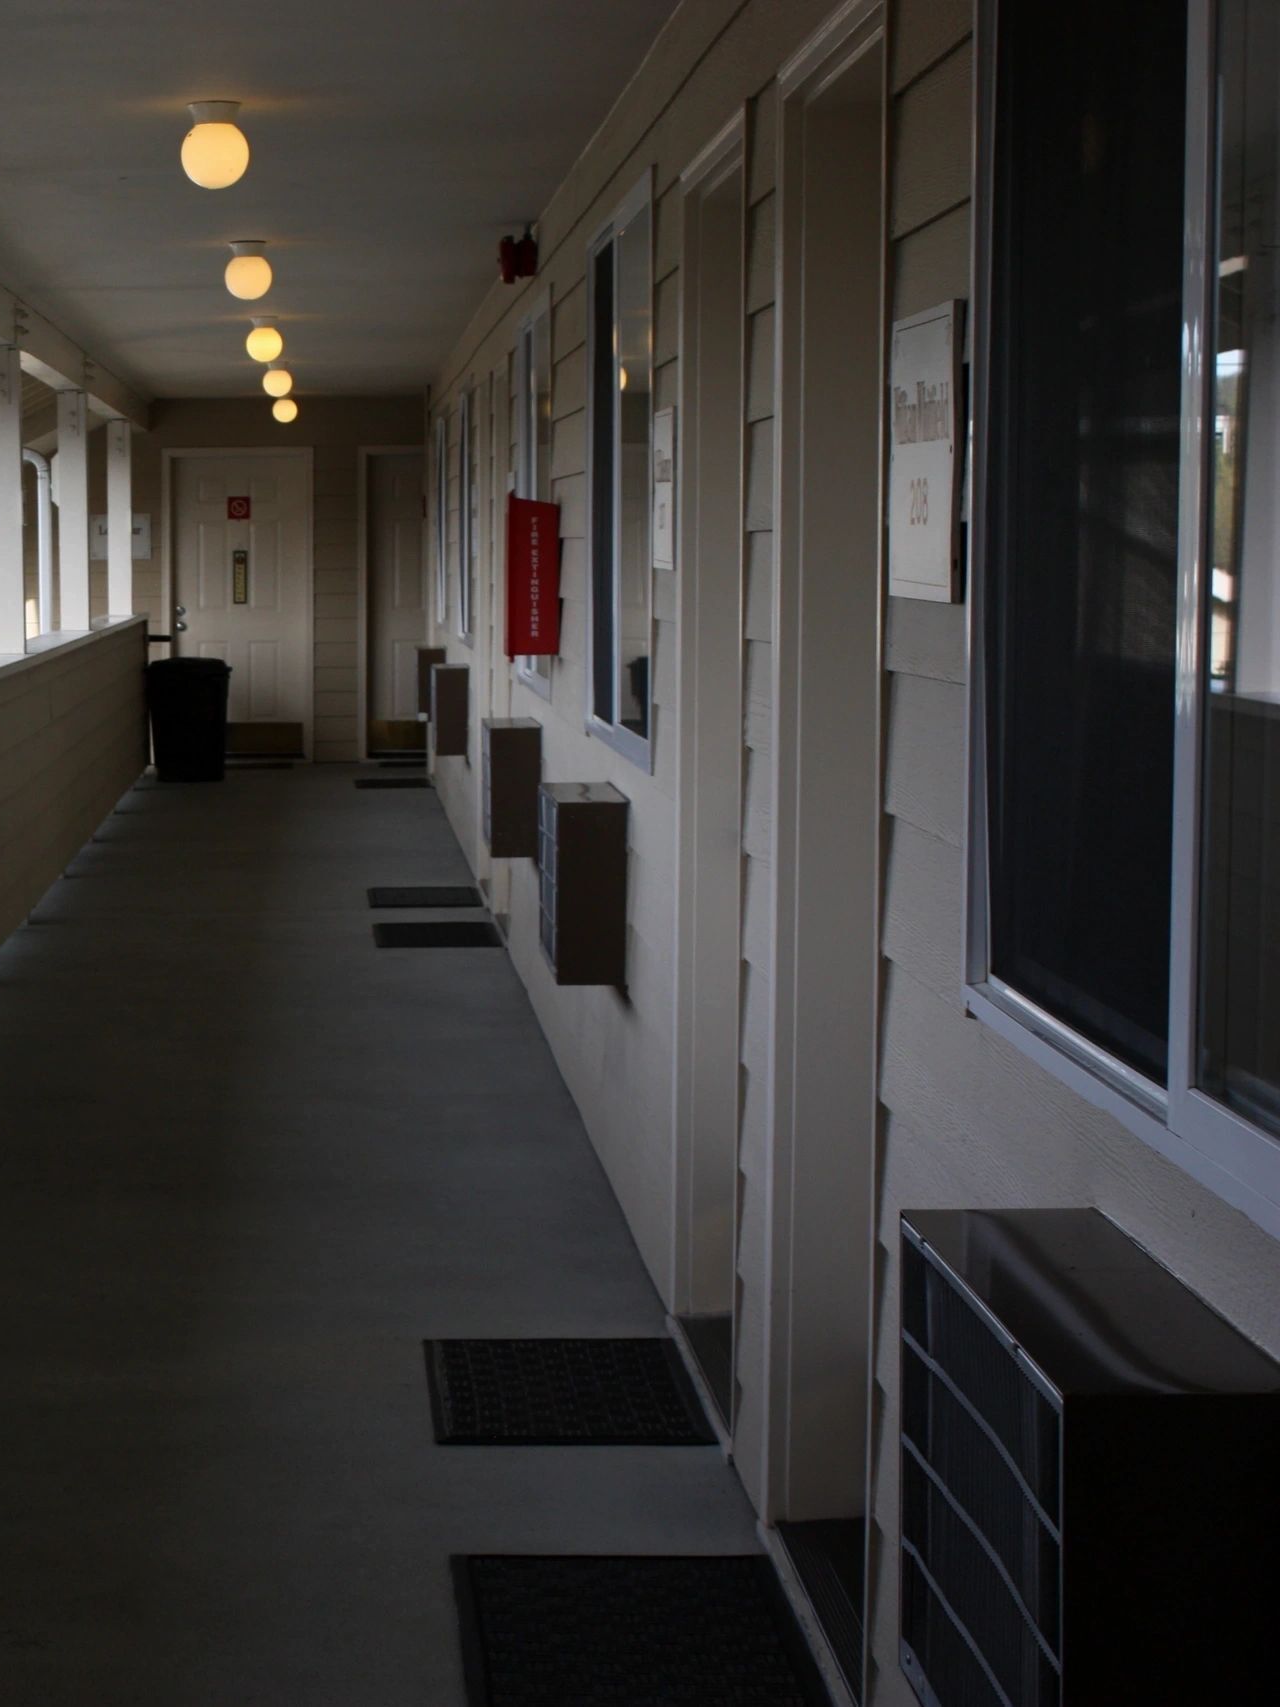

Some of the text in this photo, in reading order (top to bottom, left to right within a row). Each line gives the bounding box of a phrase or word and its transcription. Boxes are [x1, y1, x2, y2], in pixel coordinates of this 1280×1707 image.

[909, 477, 929, 526] 208
[530, 516, 540, 638] FIRE EXTINGUISHER
